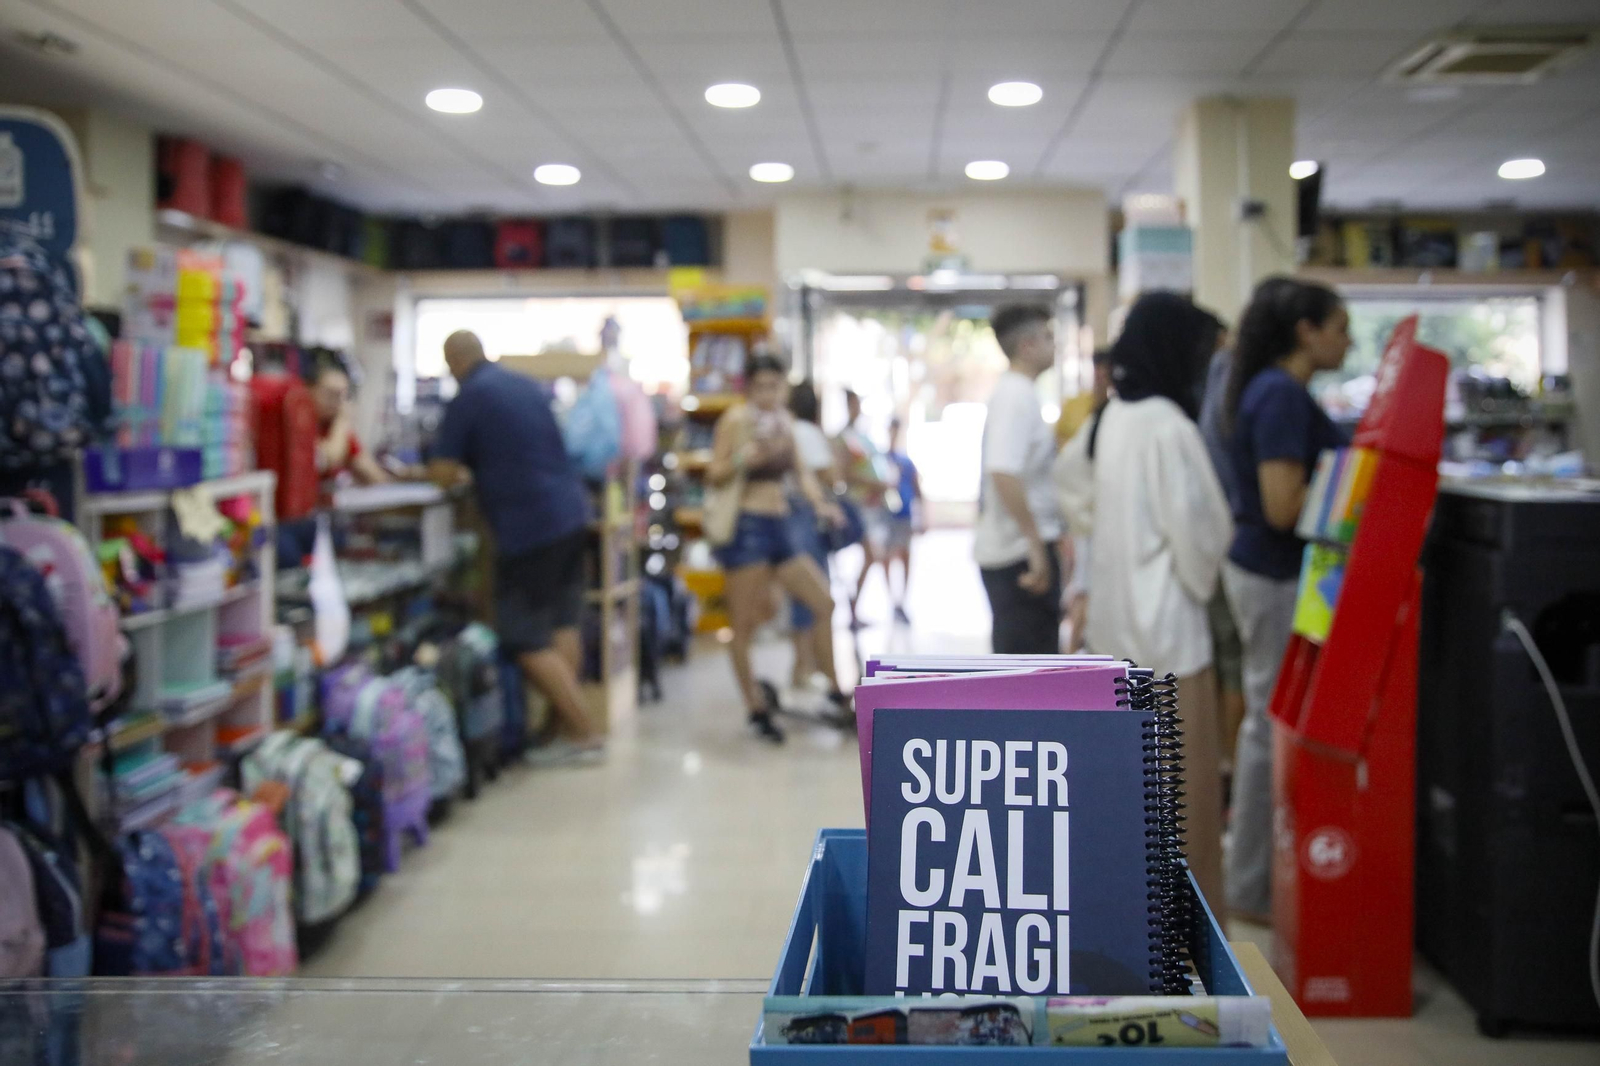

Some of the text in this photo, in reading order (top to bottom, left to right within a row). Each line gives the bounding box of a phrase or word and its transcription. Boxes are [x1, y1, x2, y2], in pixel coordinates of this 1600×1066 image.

[901, 738, 1070, 807] SUPER
[899, 806, 1070, 911] CALI
[895, 909, 1070, 994] FRAGI
